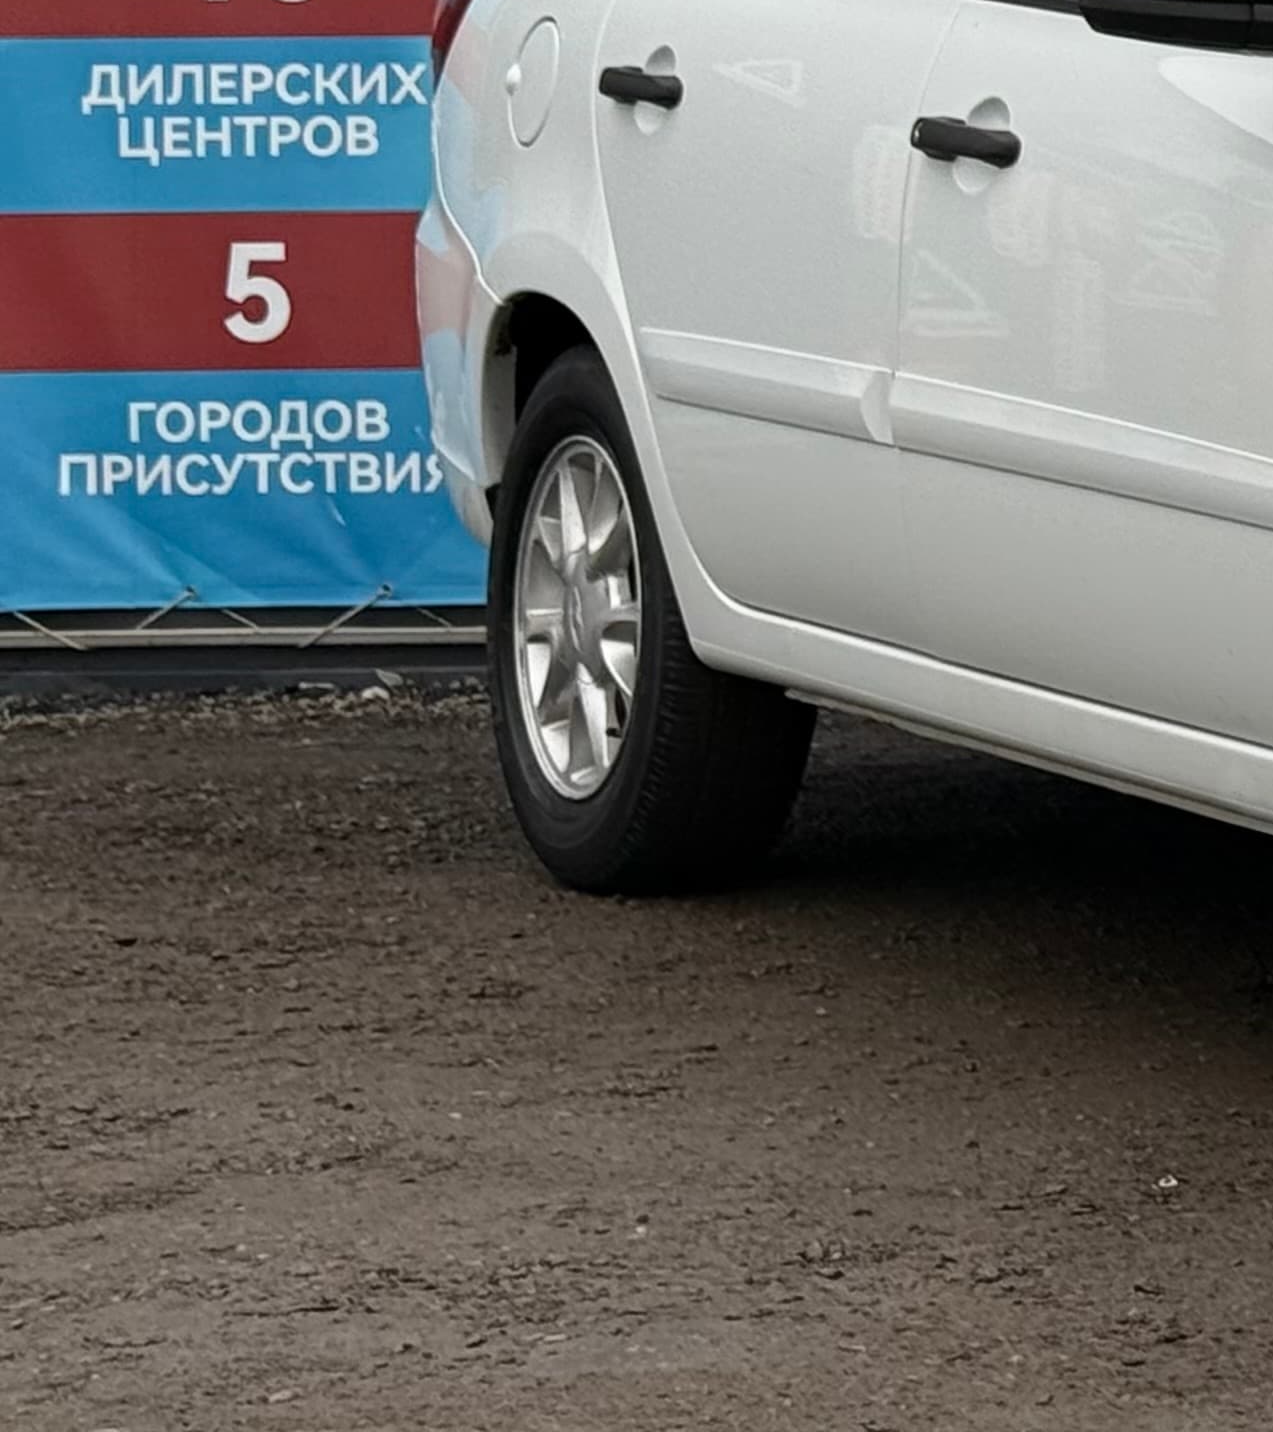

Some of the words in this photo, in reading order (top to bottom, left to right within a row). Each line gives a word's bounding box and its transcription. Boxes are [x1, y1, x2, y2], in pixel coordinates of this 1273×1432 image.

[81, 63, 426, 115] ДИЛЕРСКИХ
[118, 115, 379, 167] ЦЕНТРОВ
[224, 242, 291, 343] 5
[128, 400, 390, 446] ГОРОДОВ
